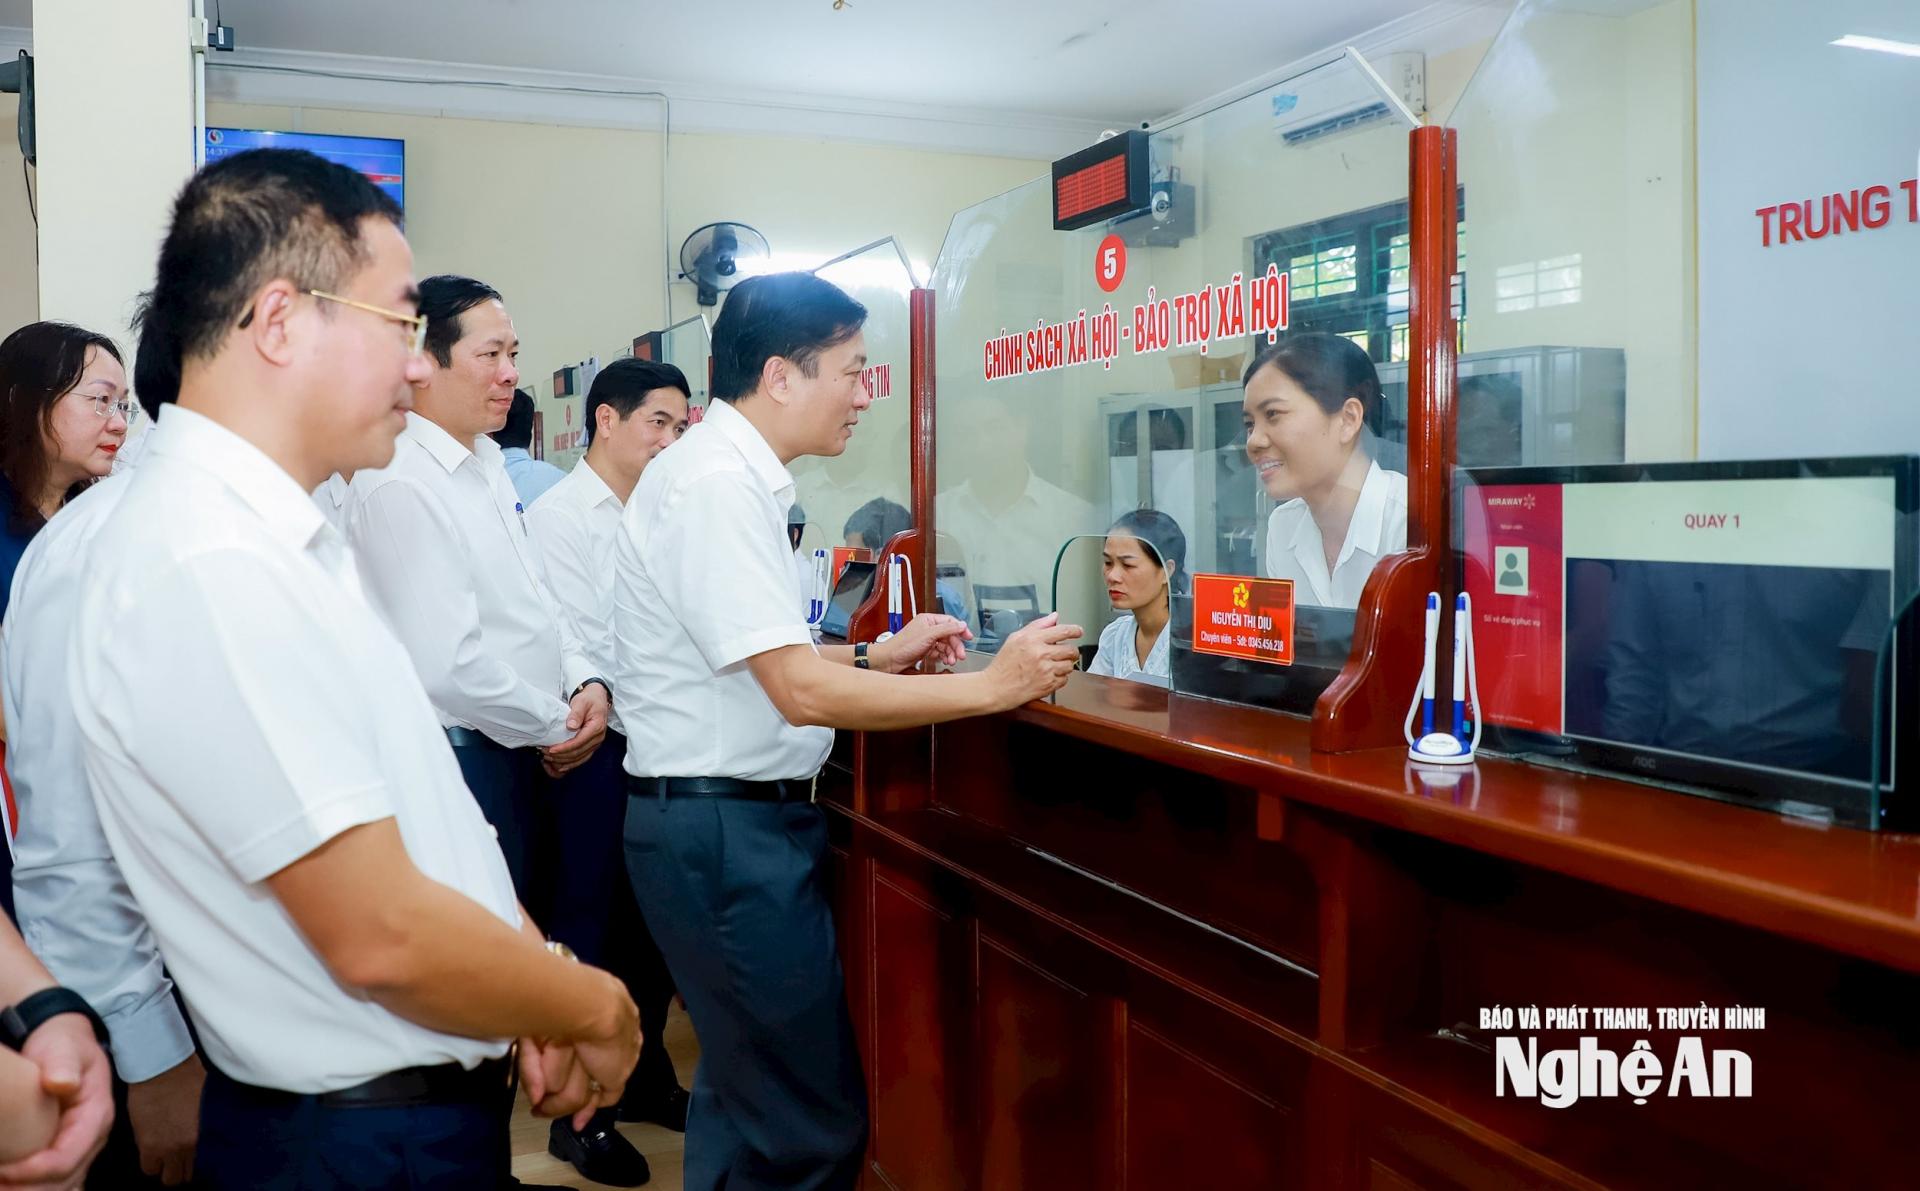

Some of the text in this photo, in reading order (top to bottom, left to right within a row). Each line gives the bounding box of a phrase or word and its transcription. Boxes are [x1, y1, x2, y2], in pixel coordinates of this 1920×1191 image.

[1755, 185, 1890, 247] TRUNG
[1103, 247, 1117, 280] 5
[984, 328, 1023, 381] CHÍNH
[1026, 319, 1063, 372] SÁCH
[1067, 309, 1088, 366] XÃ
[1091, 302, 1118, 370] HỘI
[1134, 286, 1170, 355] BẢO
[1174, 284, 1212, 355] TRỢ
[1215, 272, 1245, 341] XÃ
[1250, 263, 1289, 344] HỘI
[860, 362, 891, 401] NG TIN
[1488, 497, 1523, 506] MIRAWAY
[1684, 513, 1740, 530] QUAY 1
[1211, 608, 1272, 633] NGUYỄN THỊ DỊU
[1200, 630, 1220, 645] Chuyên
[1221, 633, 1233, 645] viên
